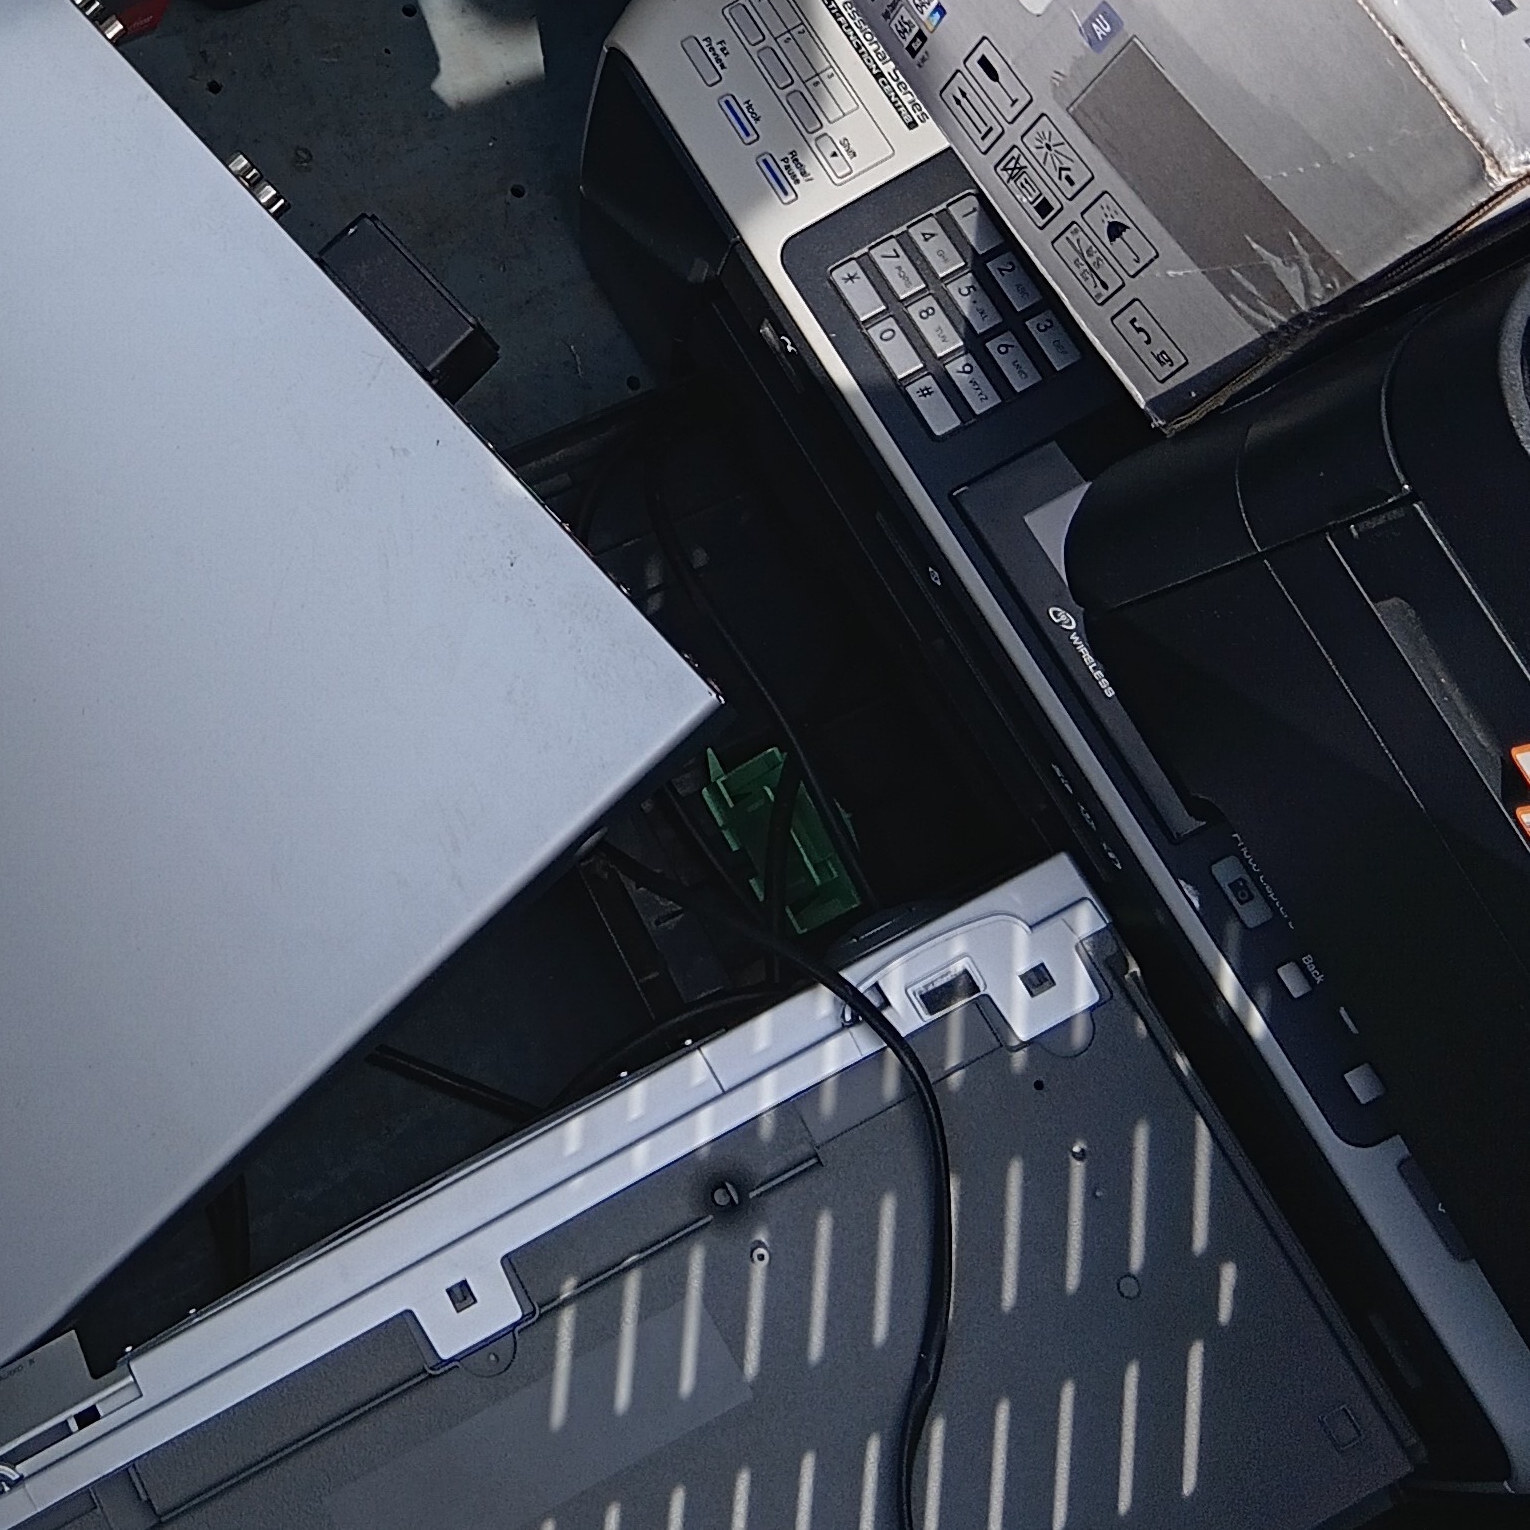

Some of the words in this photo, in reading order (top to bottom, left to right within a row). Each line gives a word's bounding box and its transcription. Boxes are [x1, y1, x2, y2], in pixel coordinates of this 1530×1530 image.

[1091, 13, 1112, 42] AU
[702, 36, 728, 71] Preview
[718, 38, 730, 58] Fax
[743, 98, 762, 125] Hook
[838, 136, 858, 162] Shift
[780, 156, 801, 187] Pause
[961, 206, 979, 219] 1
[920, 231, 939, 243] 4
[880, 247, 901, 262] 7
[996, 261, 1017, 278] 2
[957, 284, 978, 298] 5
[918, 306, 937, 321] 8
[1036, 318, 1055, 334] 3
[1129, 316, 1153, 347] 5
[878, 327, 897, 343] 0
[996, 342, 1016, 356] 6
[1151, 349, 1175, 369] kg
[955, 362, 975, 377] 9
[915, 384, 935, 399] #
[1069, 631, 1116, 698] WIRELESS
[1301, 953, 1324, 985] Back
